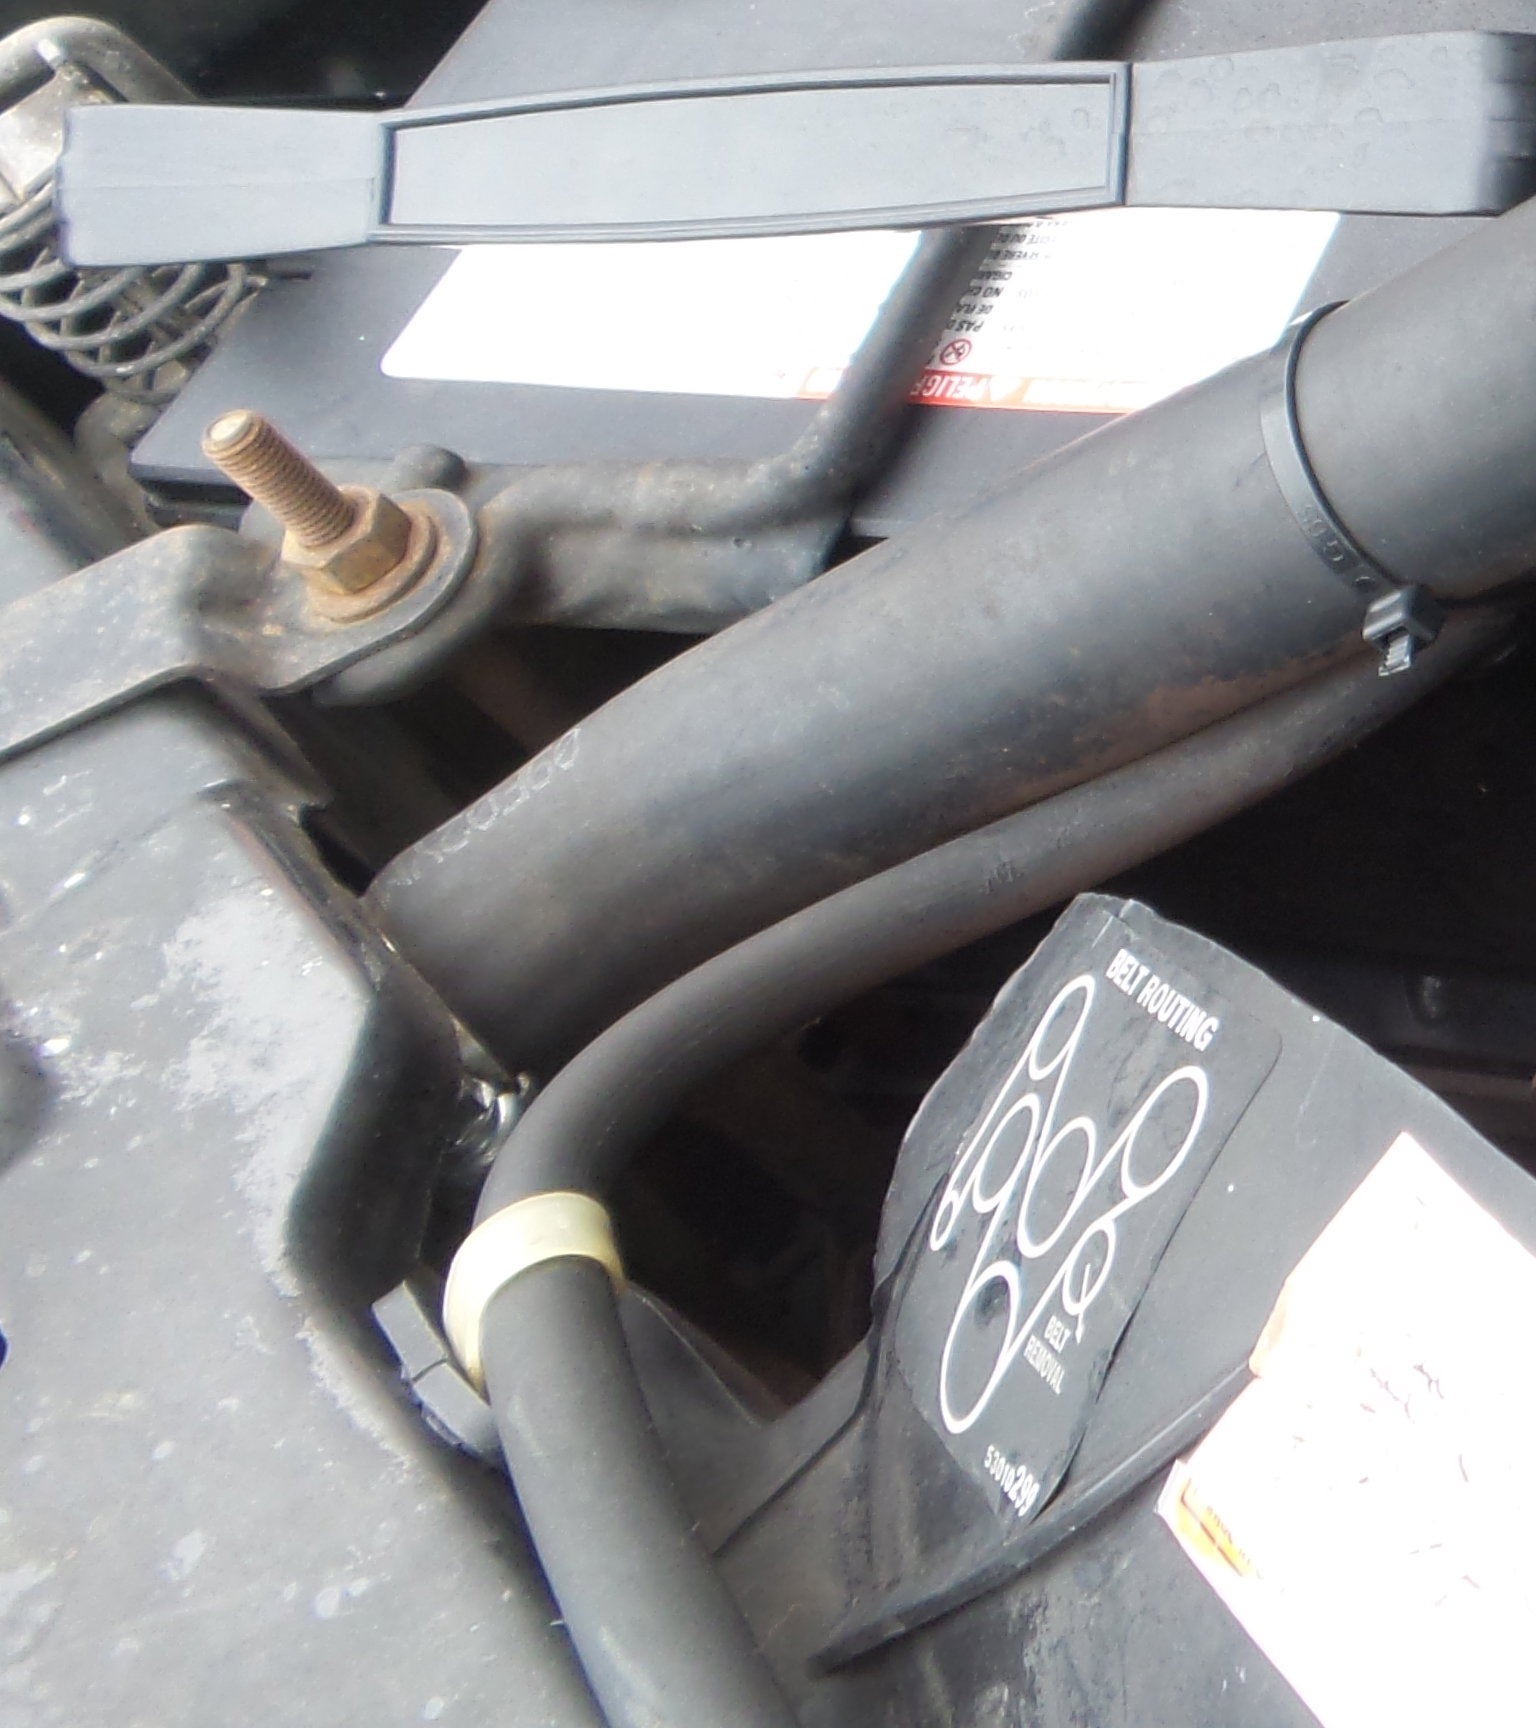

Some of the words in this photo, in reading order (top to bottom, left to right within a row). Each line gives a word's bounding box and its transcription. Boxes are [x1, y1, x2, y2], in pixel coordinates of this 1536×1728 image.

[1106, 947, 1149, 1003] BELT
[1137, 976, 1220, 1052] ROUTING
[1023, 1334, 1067, 1396] REMOVAL
[1044, 1315, 1072, 1354] BELT
